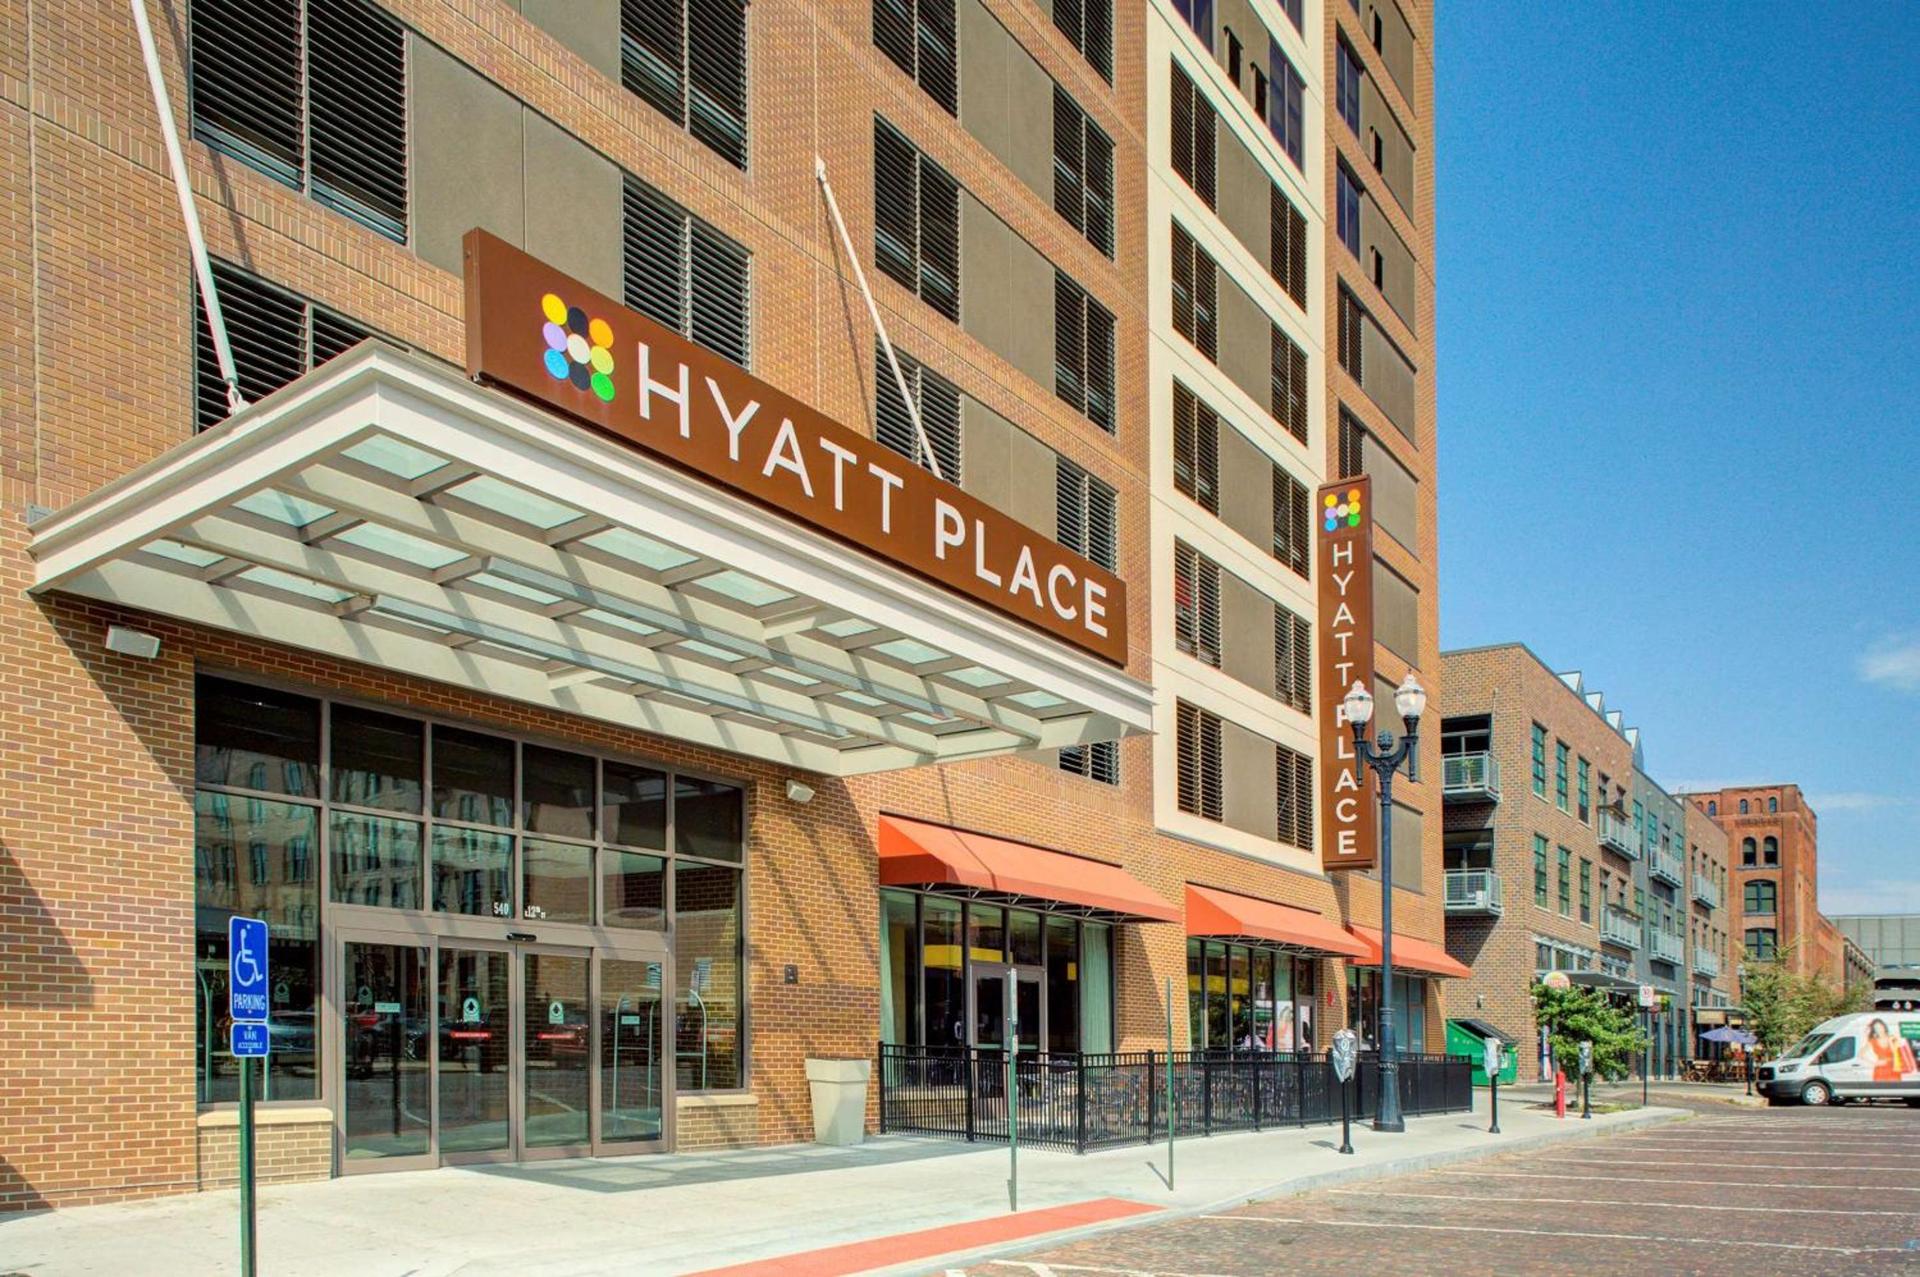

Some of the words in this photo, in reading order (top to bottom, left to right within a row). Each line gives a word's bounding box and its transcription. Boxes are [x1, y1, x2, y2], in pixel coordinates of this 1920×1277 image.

[638, 341, 904, 535] HYATT
[935, 498, 1108, 639] PLACE
[1332, 541, 1356, 687] HYATT
[1334, 704, 1359, 855] PLACE
[493, 901, 509, 915] 540
[234, 993, 265, 1010] PARKING
[244, 1030, 257, 1040] VAN
